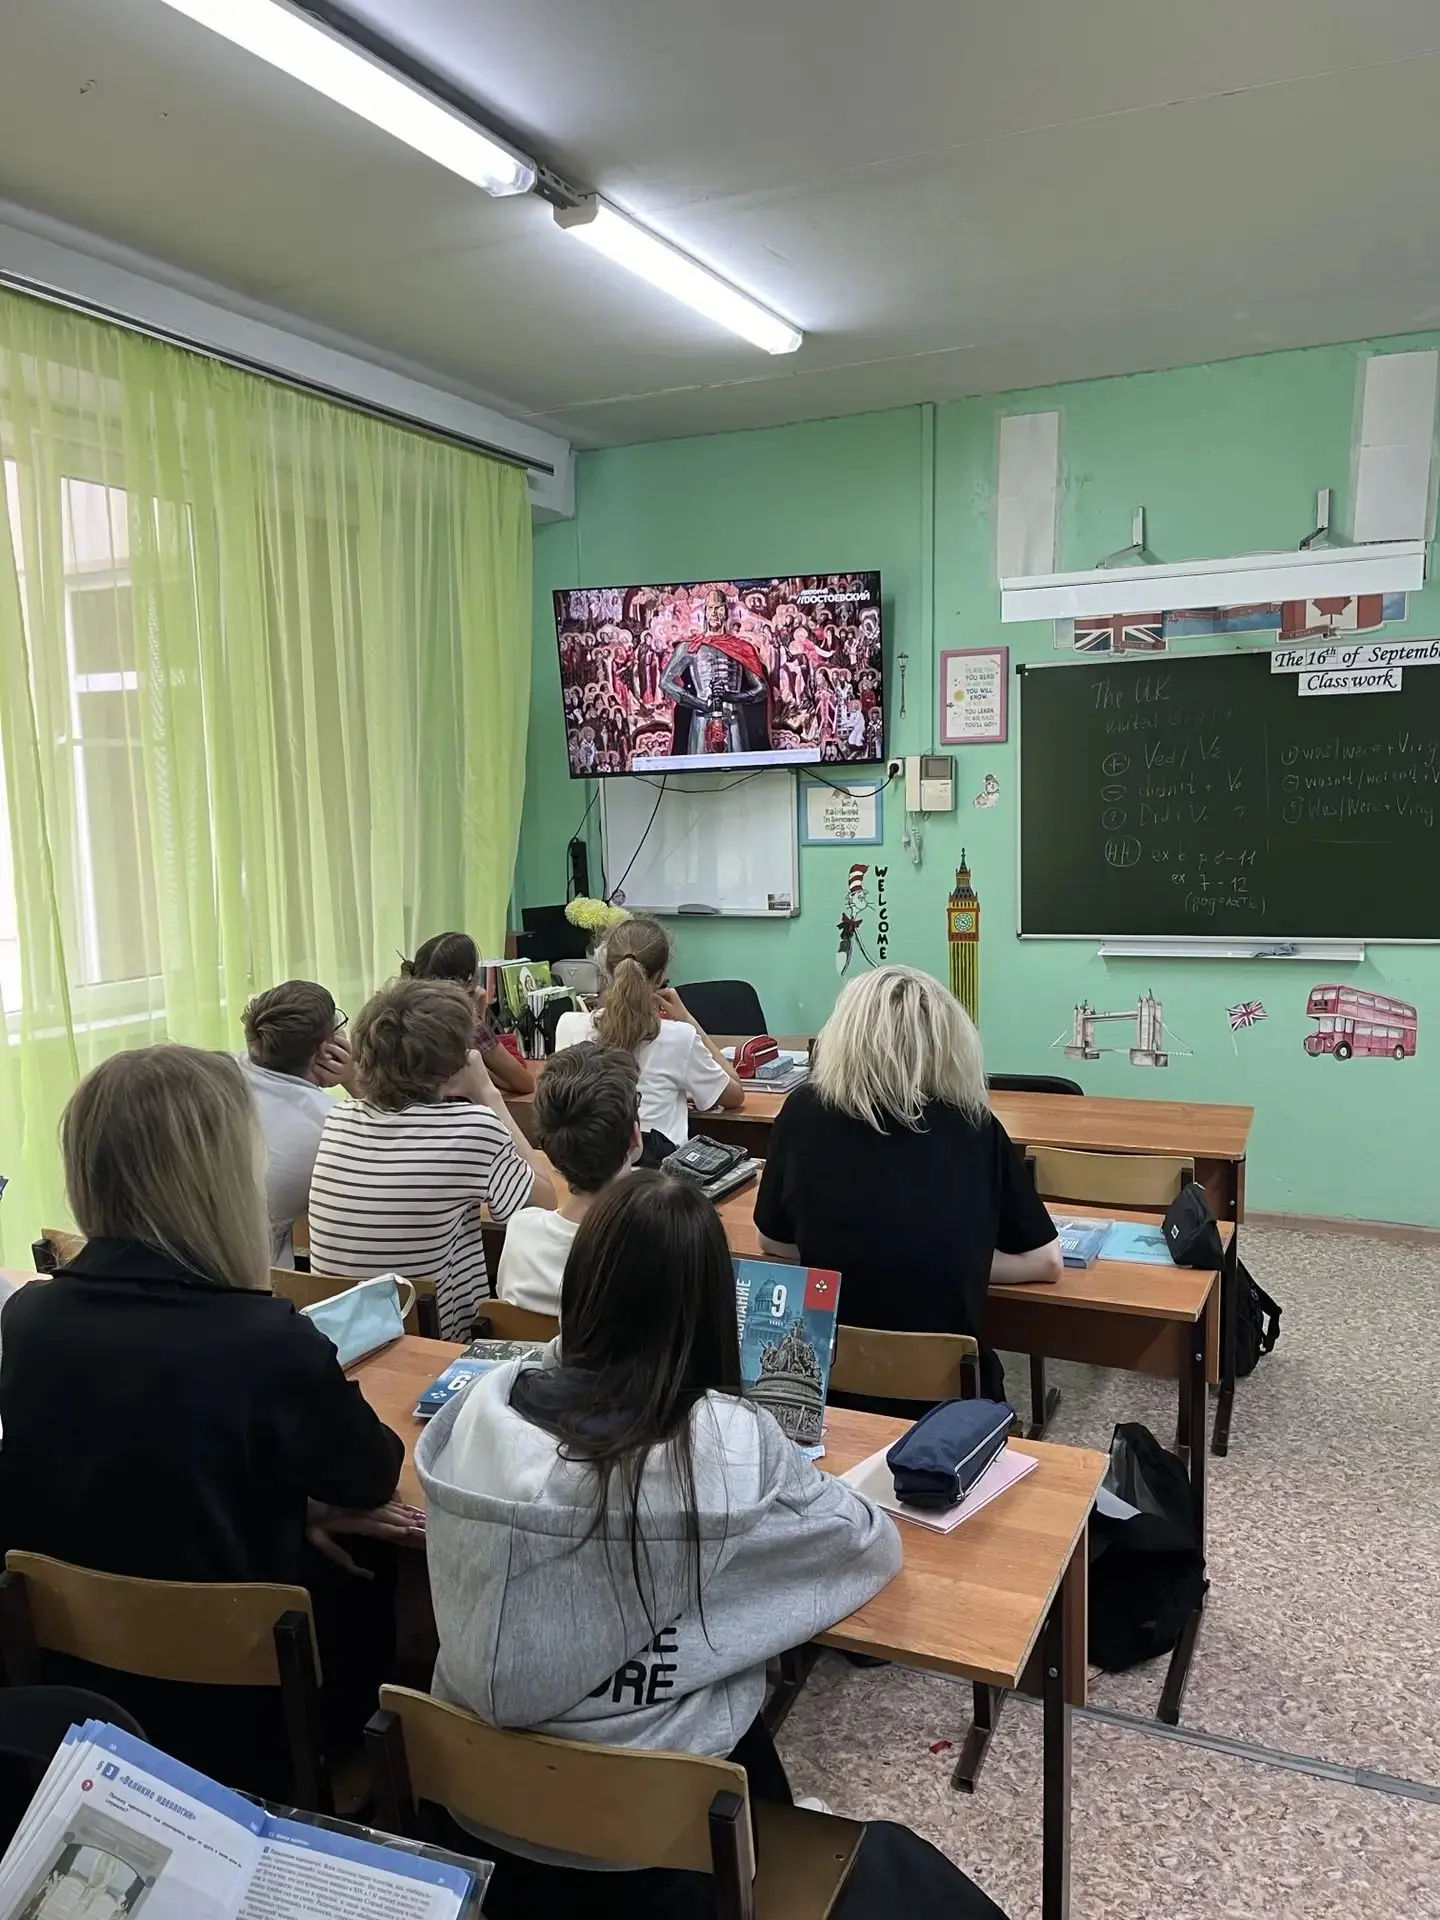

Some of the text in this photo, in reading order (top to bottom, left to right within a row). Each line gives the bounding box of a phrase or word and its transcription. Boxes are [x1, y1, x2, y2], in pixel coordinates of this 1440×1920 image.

[1275, 650, 1304, 667] The
[1342, 646, 1364, 668] of
[1368, 641, 1440, 665] Septemb
[1091, 674, 1173, 709] The UK
[874, 865, 890, 960] WELCOME
[771, 1284, 788, 1318] 9
[587, 1660, 678, 1706] RE
